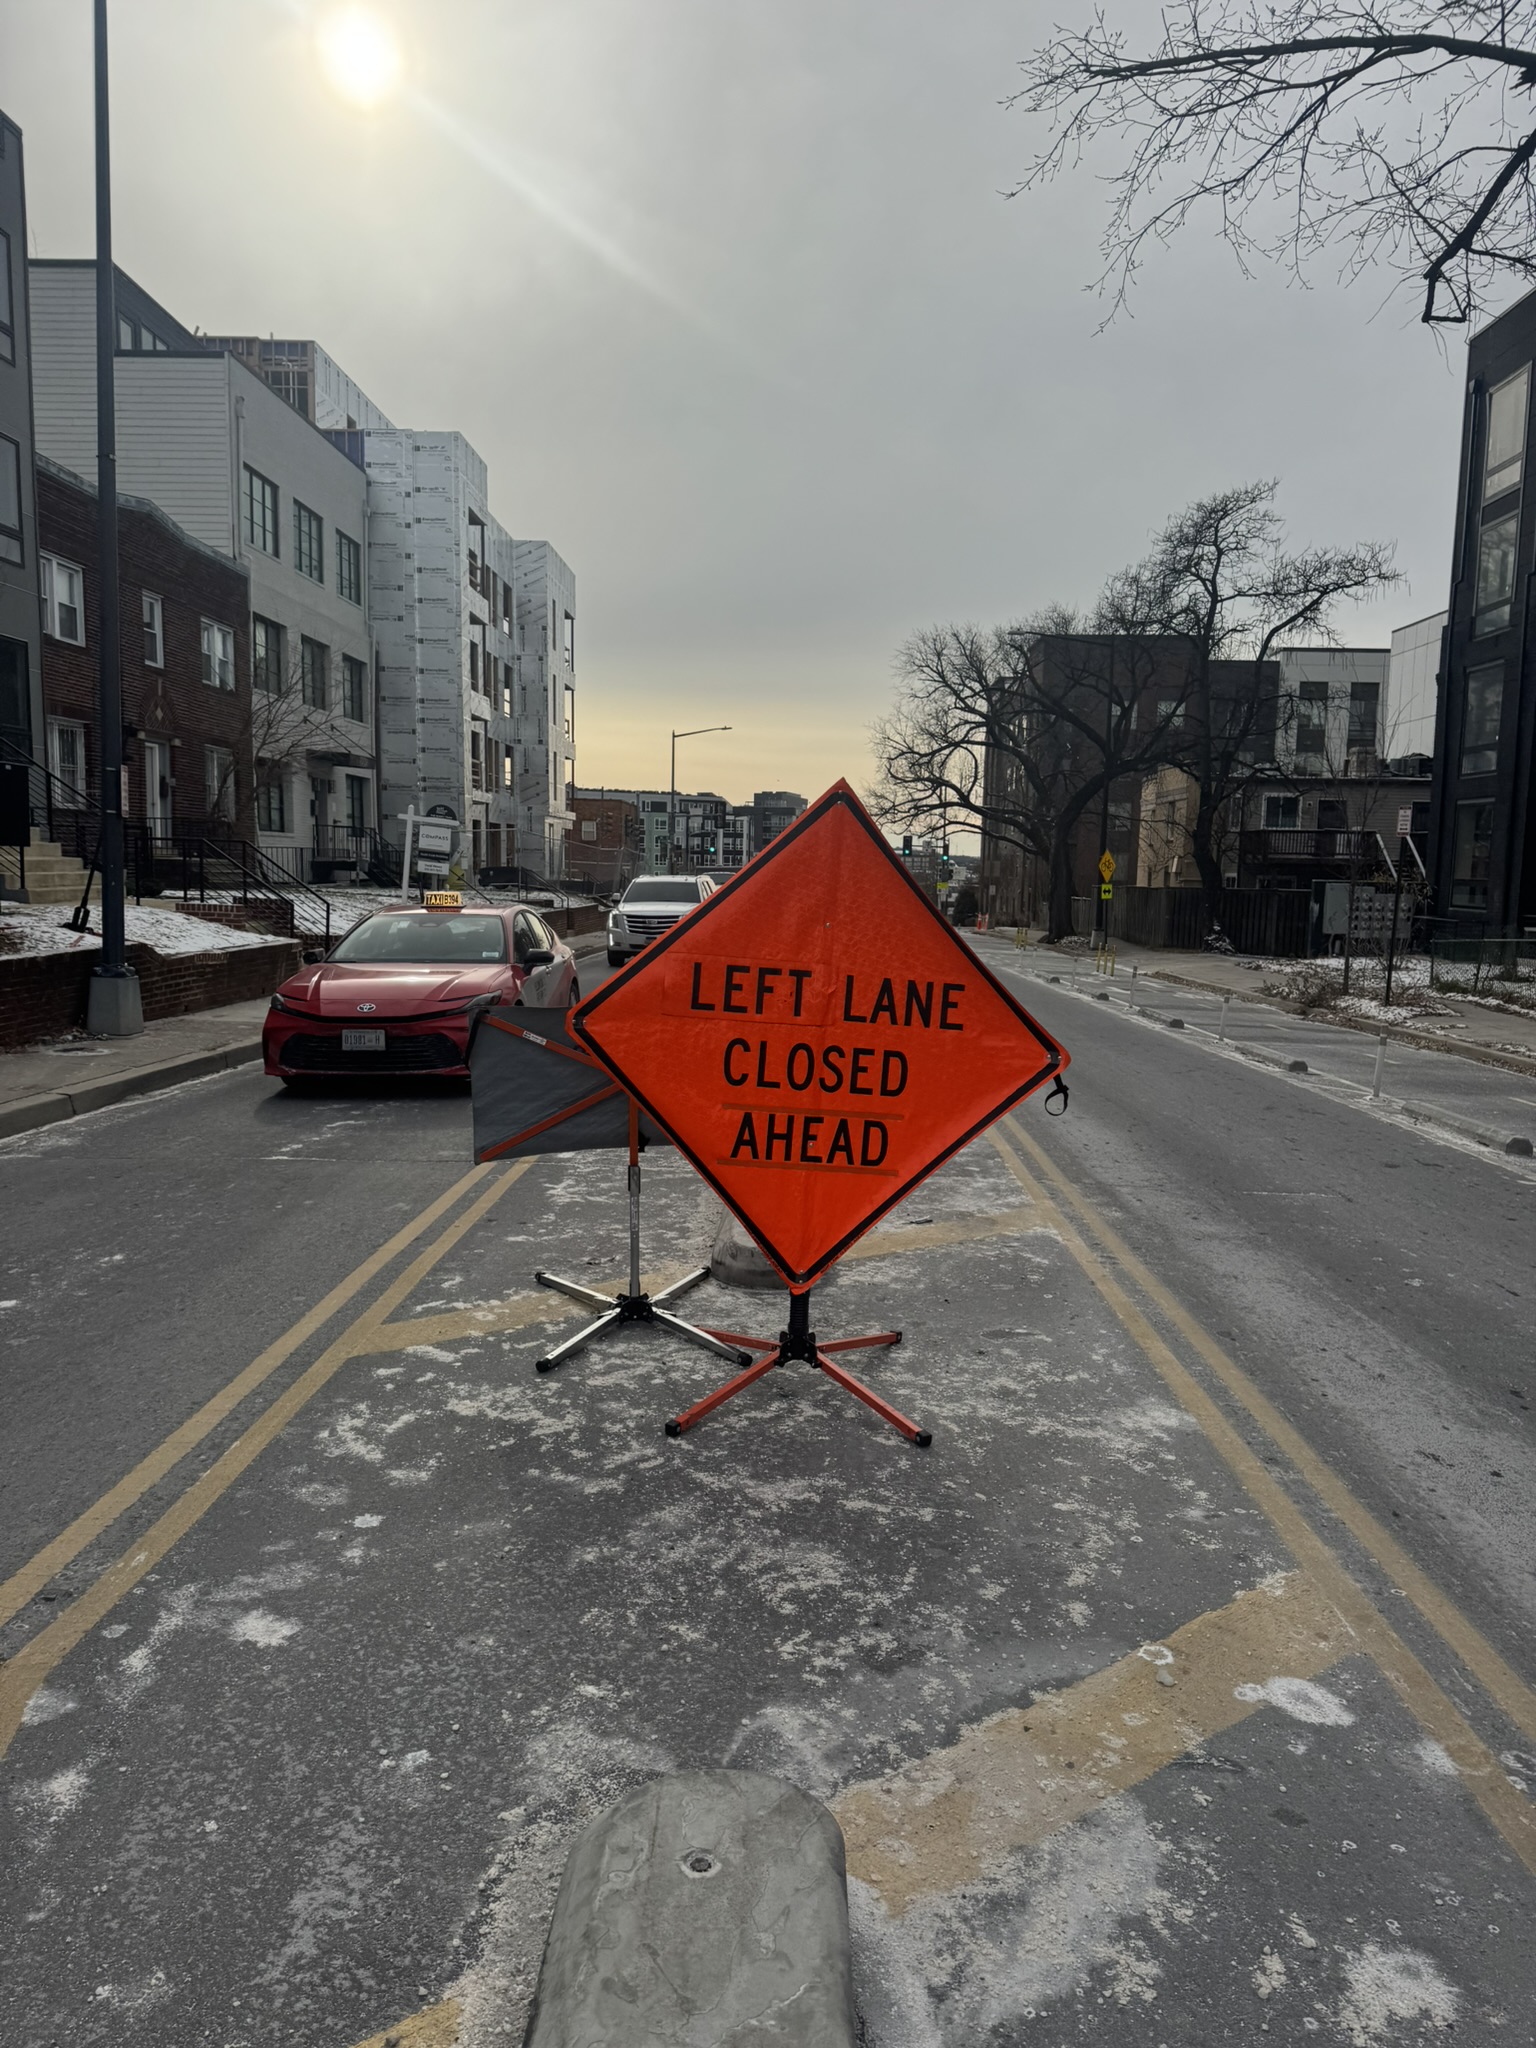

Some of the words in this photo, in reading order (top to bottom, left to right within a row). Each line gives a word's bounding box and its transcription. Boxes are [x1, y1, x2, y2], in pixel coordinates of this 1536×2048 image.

[421, 833, 449, 841] COMPASS
[427, 894, 444, 905] TAXI
[690, 961, 813, 1017] LEFT
[843, 974, 966, 1032] LANE
[723, 1037, 909, 1098] CLOSED
[730, 1112, 889, 1167] AHEAD
